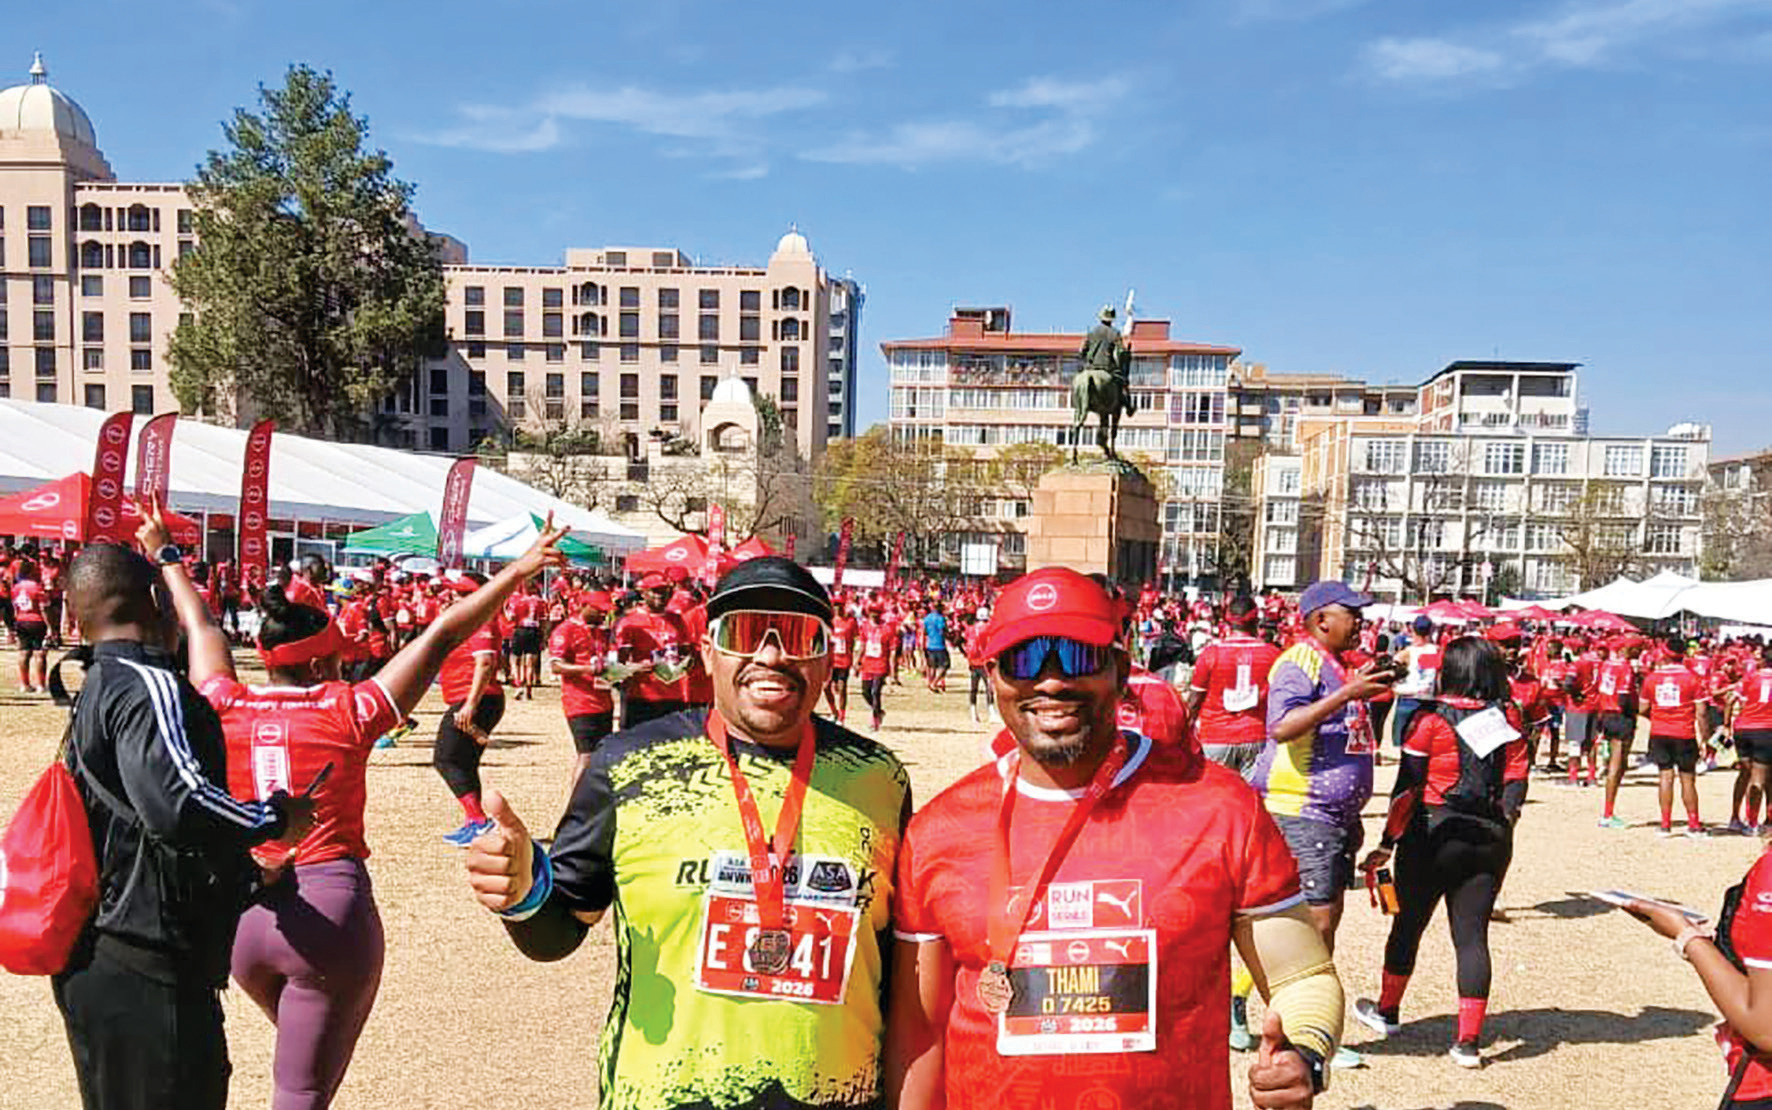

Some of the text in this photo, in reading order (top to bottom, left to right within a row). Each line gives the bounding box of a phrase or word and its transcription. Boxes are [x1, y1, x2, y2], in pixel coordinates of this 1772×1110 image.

[813, 863, 847, 880] ASA
[1051, 888, 1090, 904] RUN
[707, 923, 730, 969] E
[771, 979, 814, 996] 2026
[1046, 966, 1099, 995] THAMI
[1059, 996, 1111, 1013] 7425
[1069, 1016, 1118, 1032] 2026
